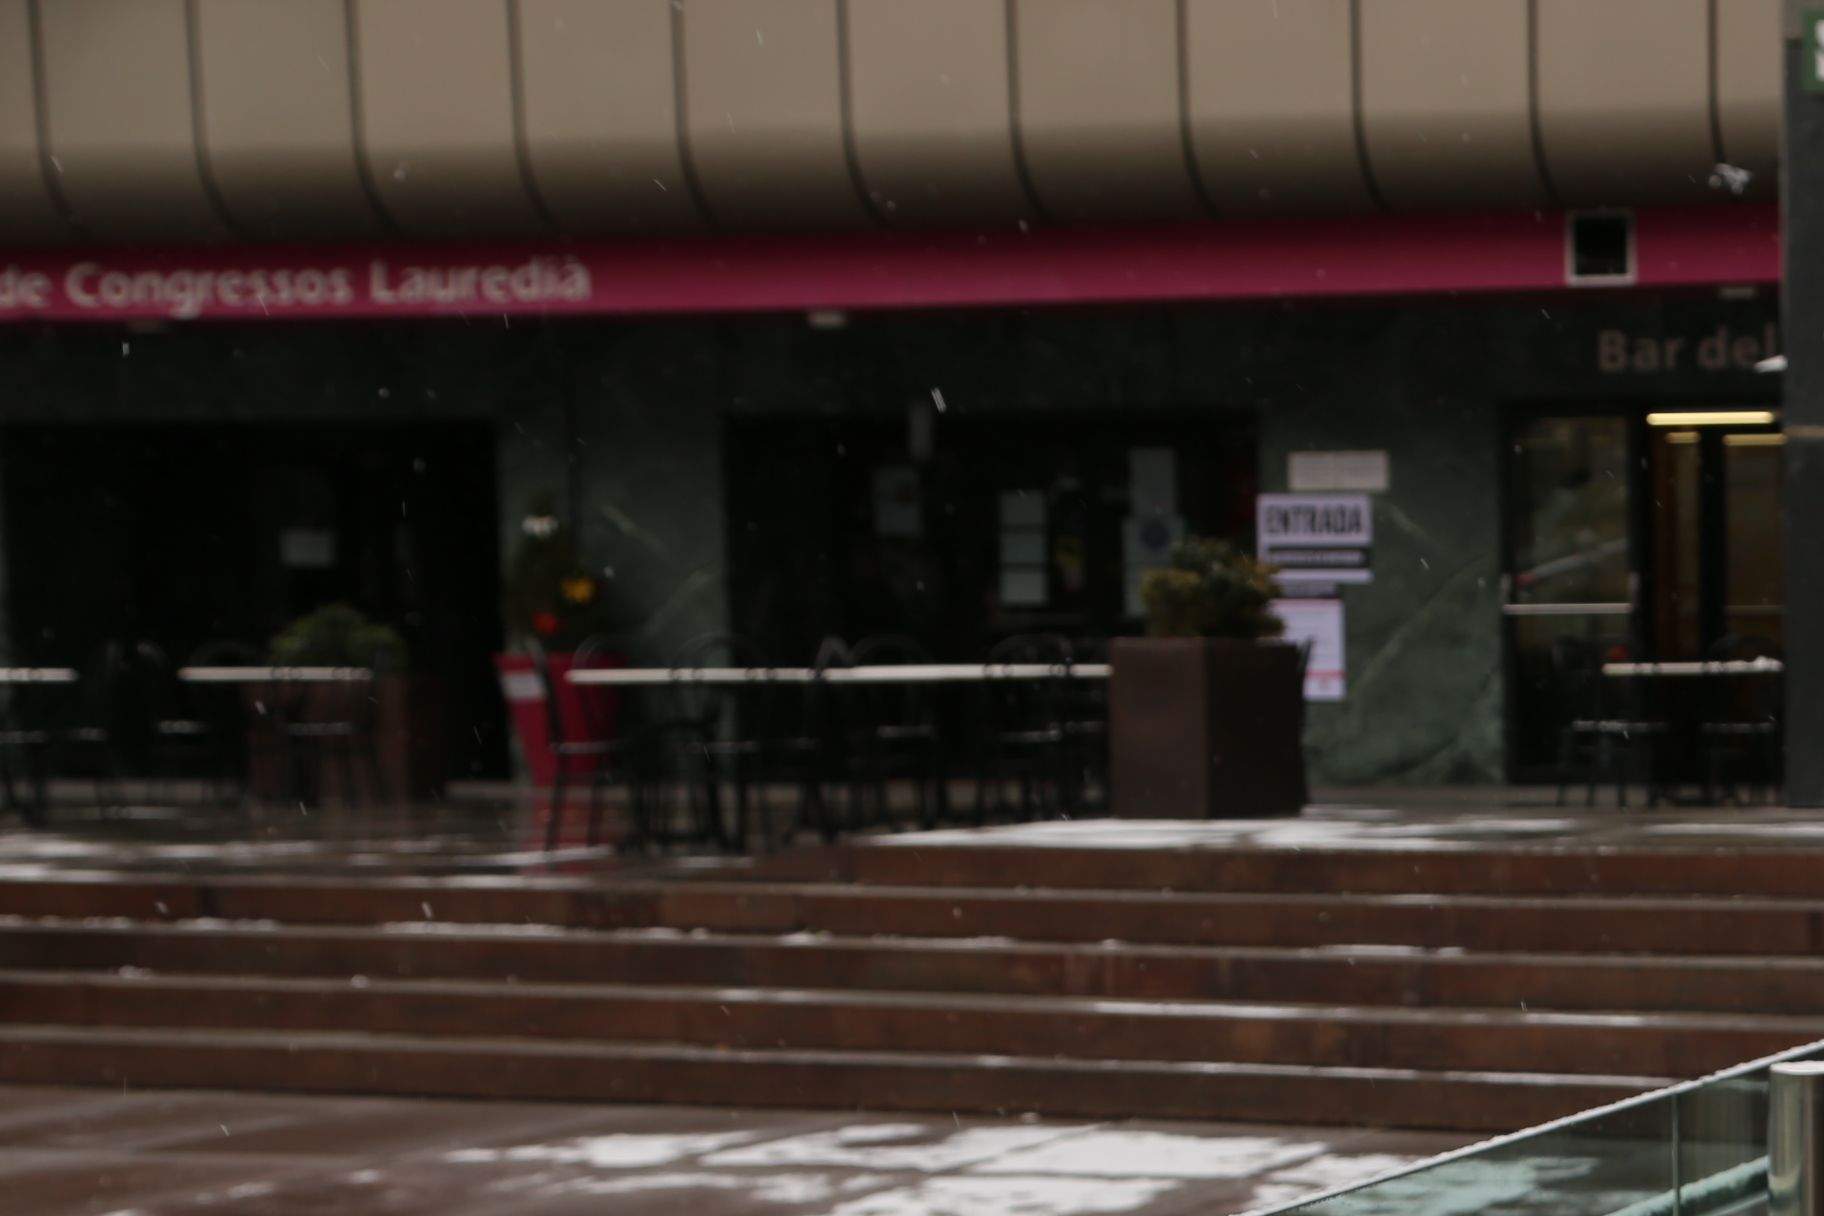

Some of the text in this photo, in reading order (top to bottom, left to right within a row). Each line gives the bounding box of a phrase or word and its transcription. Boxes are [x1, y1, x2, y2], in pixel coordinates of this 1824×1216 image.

[65, 262, 355, 321] Congressos
[370, 252, 594, 305] Lauredià
[1598, 328, 1685, 375] Bar
[1265, 502, 1363, 536] ENTRADA
